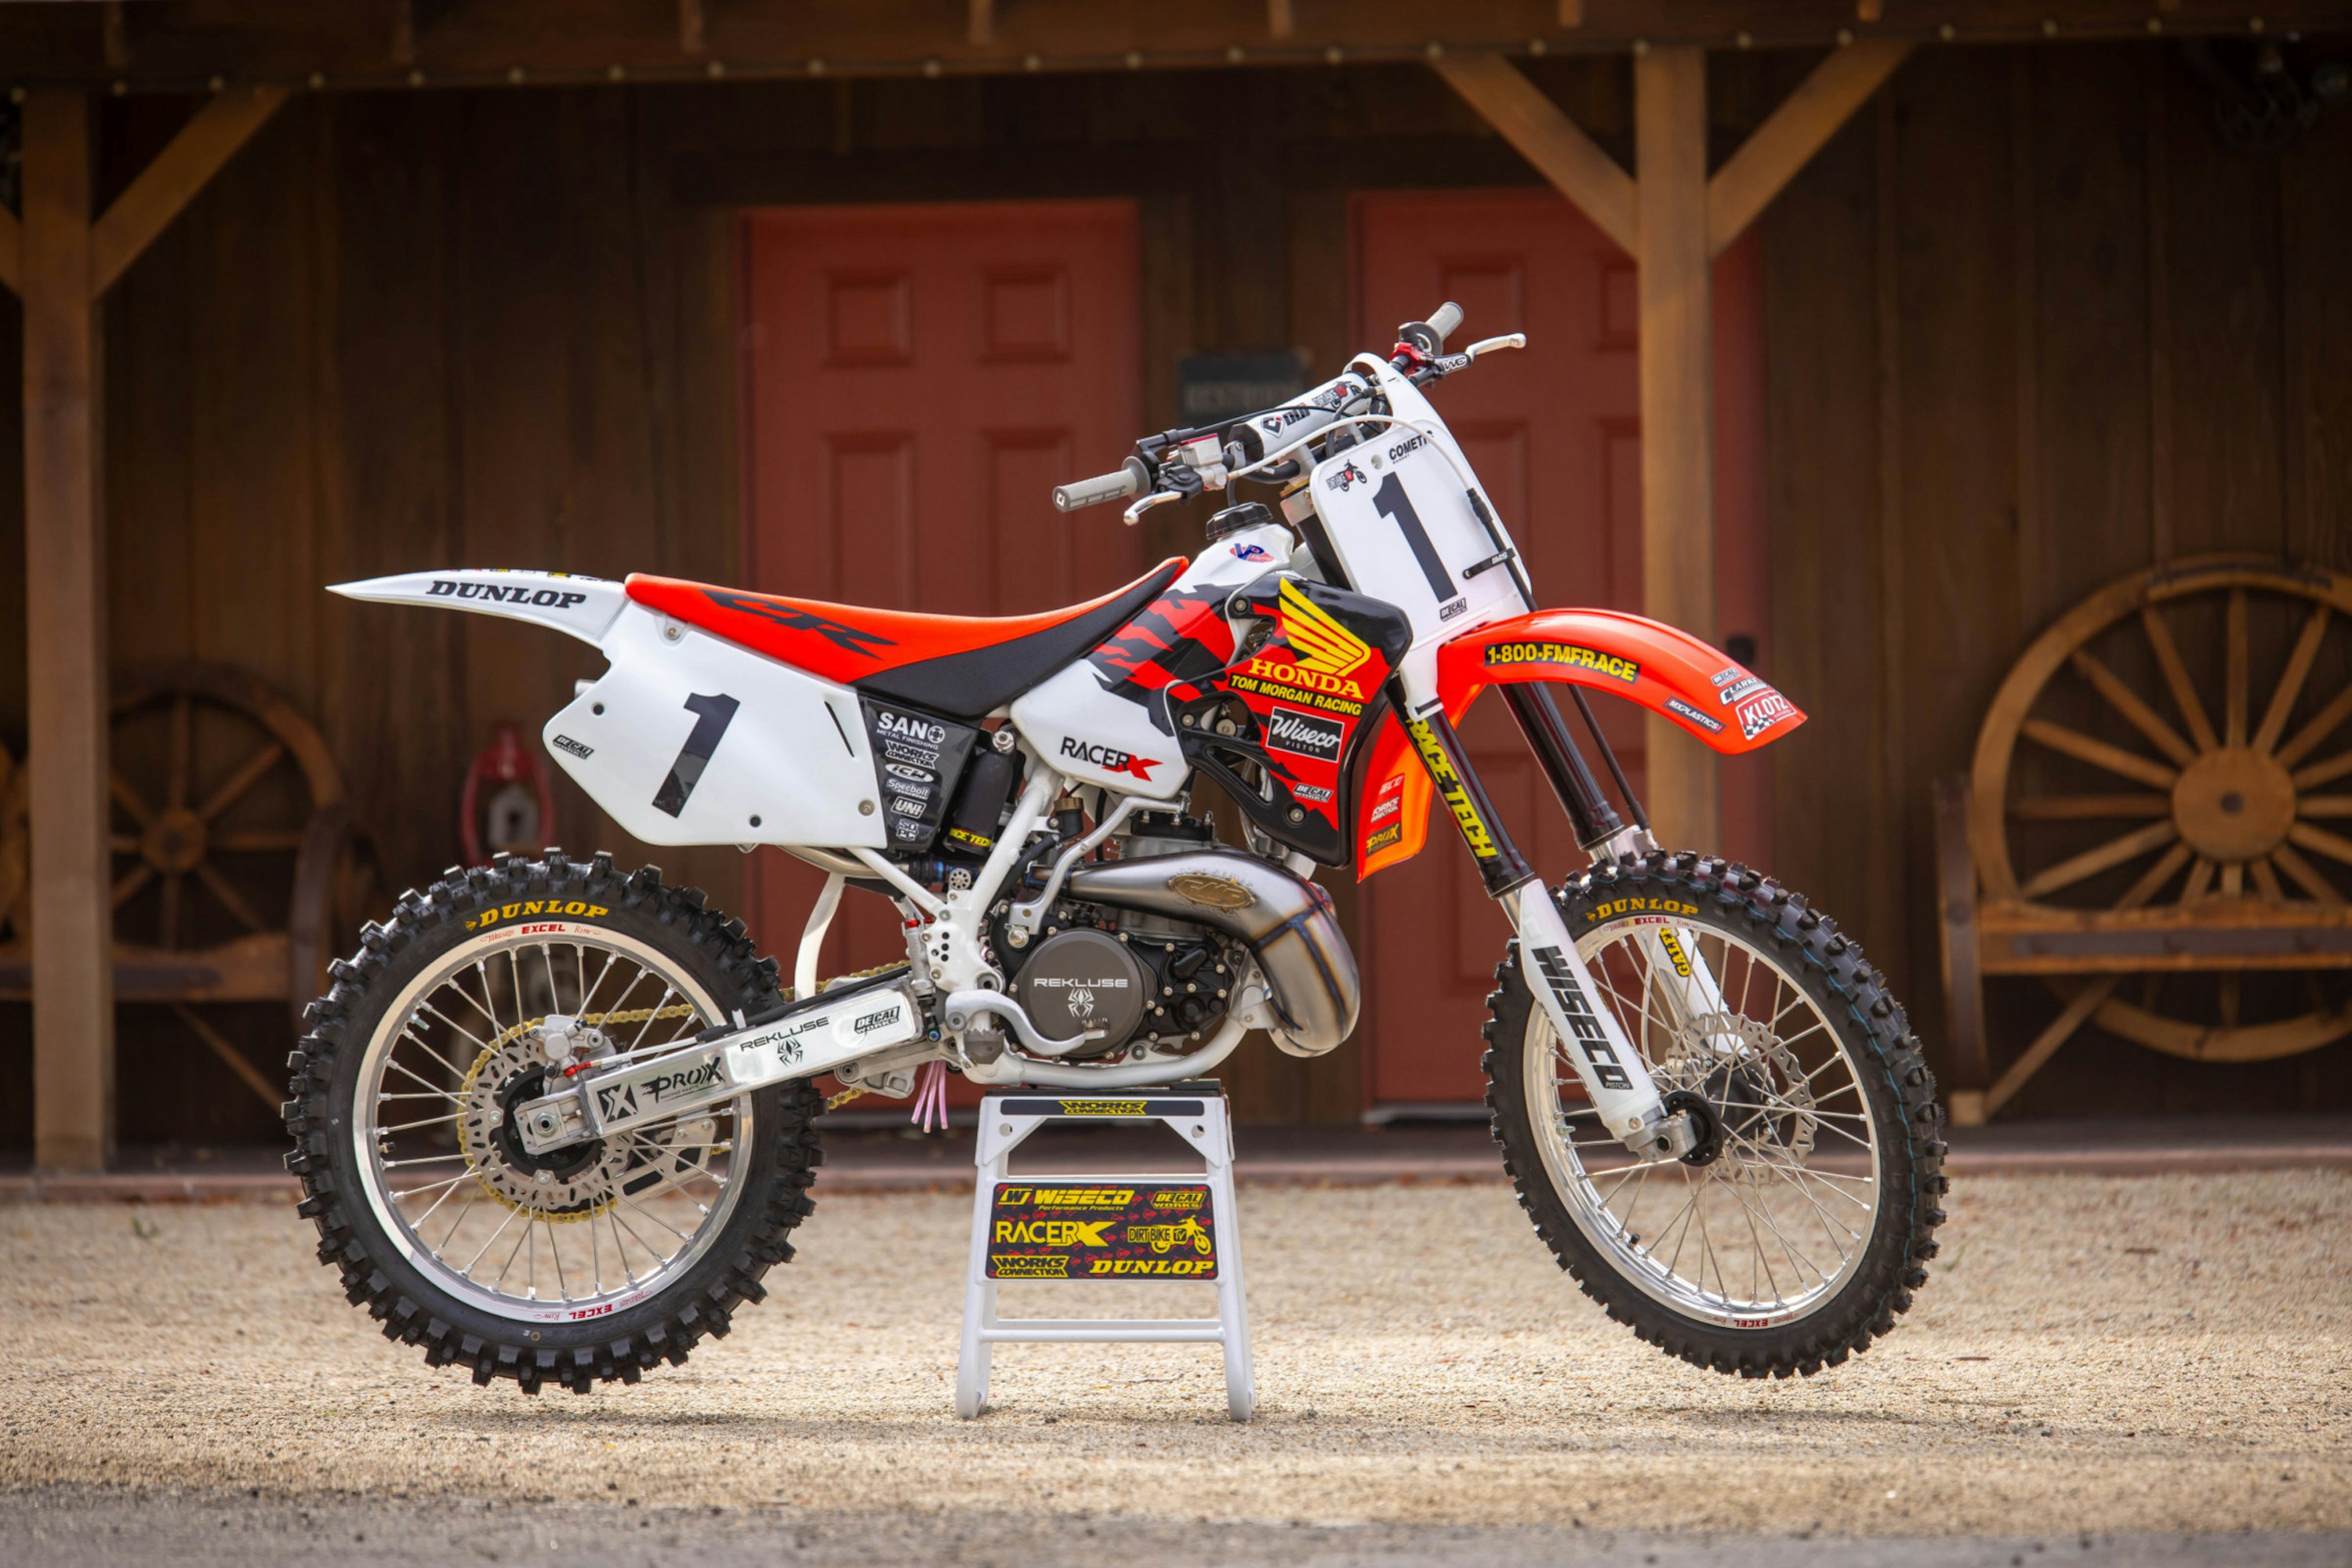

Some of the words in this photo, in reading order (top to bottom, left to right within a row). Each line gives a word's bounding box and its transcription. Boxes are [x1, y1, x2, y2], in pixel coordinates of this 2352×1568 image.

[1373, 470, 1458, 604] 1
[1491, 552, 1508, 564] IMS
[426, 580, 586, 608] DUNLOP
[1488, 644, 1637, 682] 1-800-FMFRACE
[1248, 658, 1365, 699] HONDA
[1231, 675, 1257, 691] TOM
[1258, 681, 1313, 705] MORGAN
[1314, 695, 1363, 716] RACING
[1744, 695, 1789, 726] KLOTZ
[877, 728, 901, 740] METAL
[902, 735, 939, 750] FINISHING
[1272, 715, 1341, 749] Wiseco
[652, 692, 741, 818] 1
[887, 742, 938, 761] WORKS
[1285, 740, 1320, 753] PISTON
[895, 799, 923, 816] UNI
[1444, 784, 1498, 858] TECH
[479, 900, 609, 927] DUNLOP
[1596, 898, 1699, 919] DUNLOP
[521, 924, 566, 935] EXCEL
[1634, 916, 1671, 925] EXCEL
[1034, 978, 1129, 988] REKLUSE
[855, 1007, 900, 1029] DECAL
[740, 1016, 830, 1052] REKLUSE
[1605, 1081, 1631, 1090] PISTON
[1064, 1101, 1145, 1109] WORKS
[1155, 1192, 1203, 1203] DECAL
[996, 1257, 1065, 1268] WORKS
[1089, 1260, 1214, 1274] DUNLOP
[568, 1304, 613, 1319] EXCEL
[1733, 1319, 1769, 1328] EXCEL
